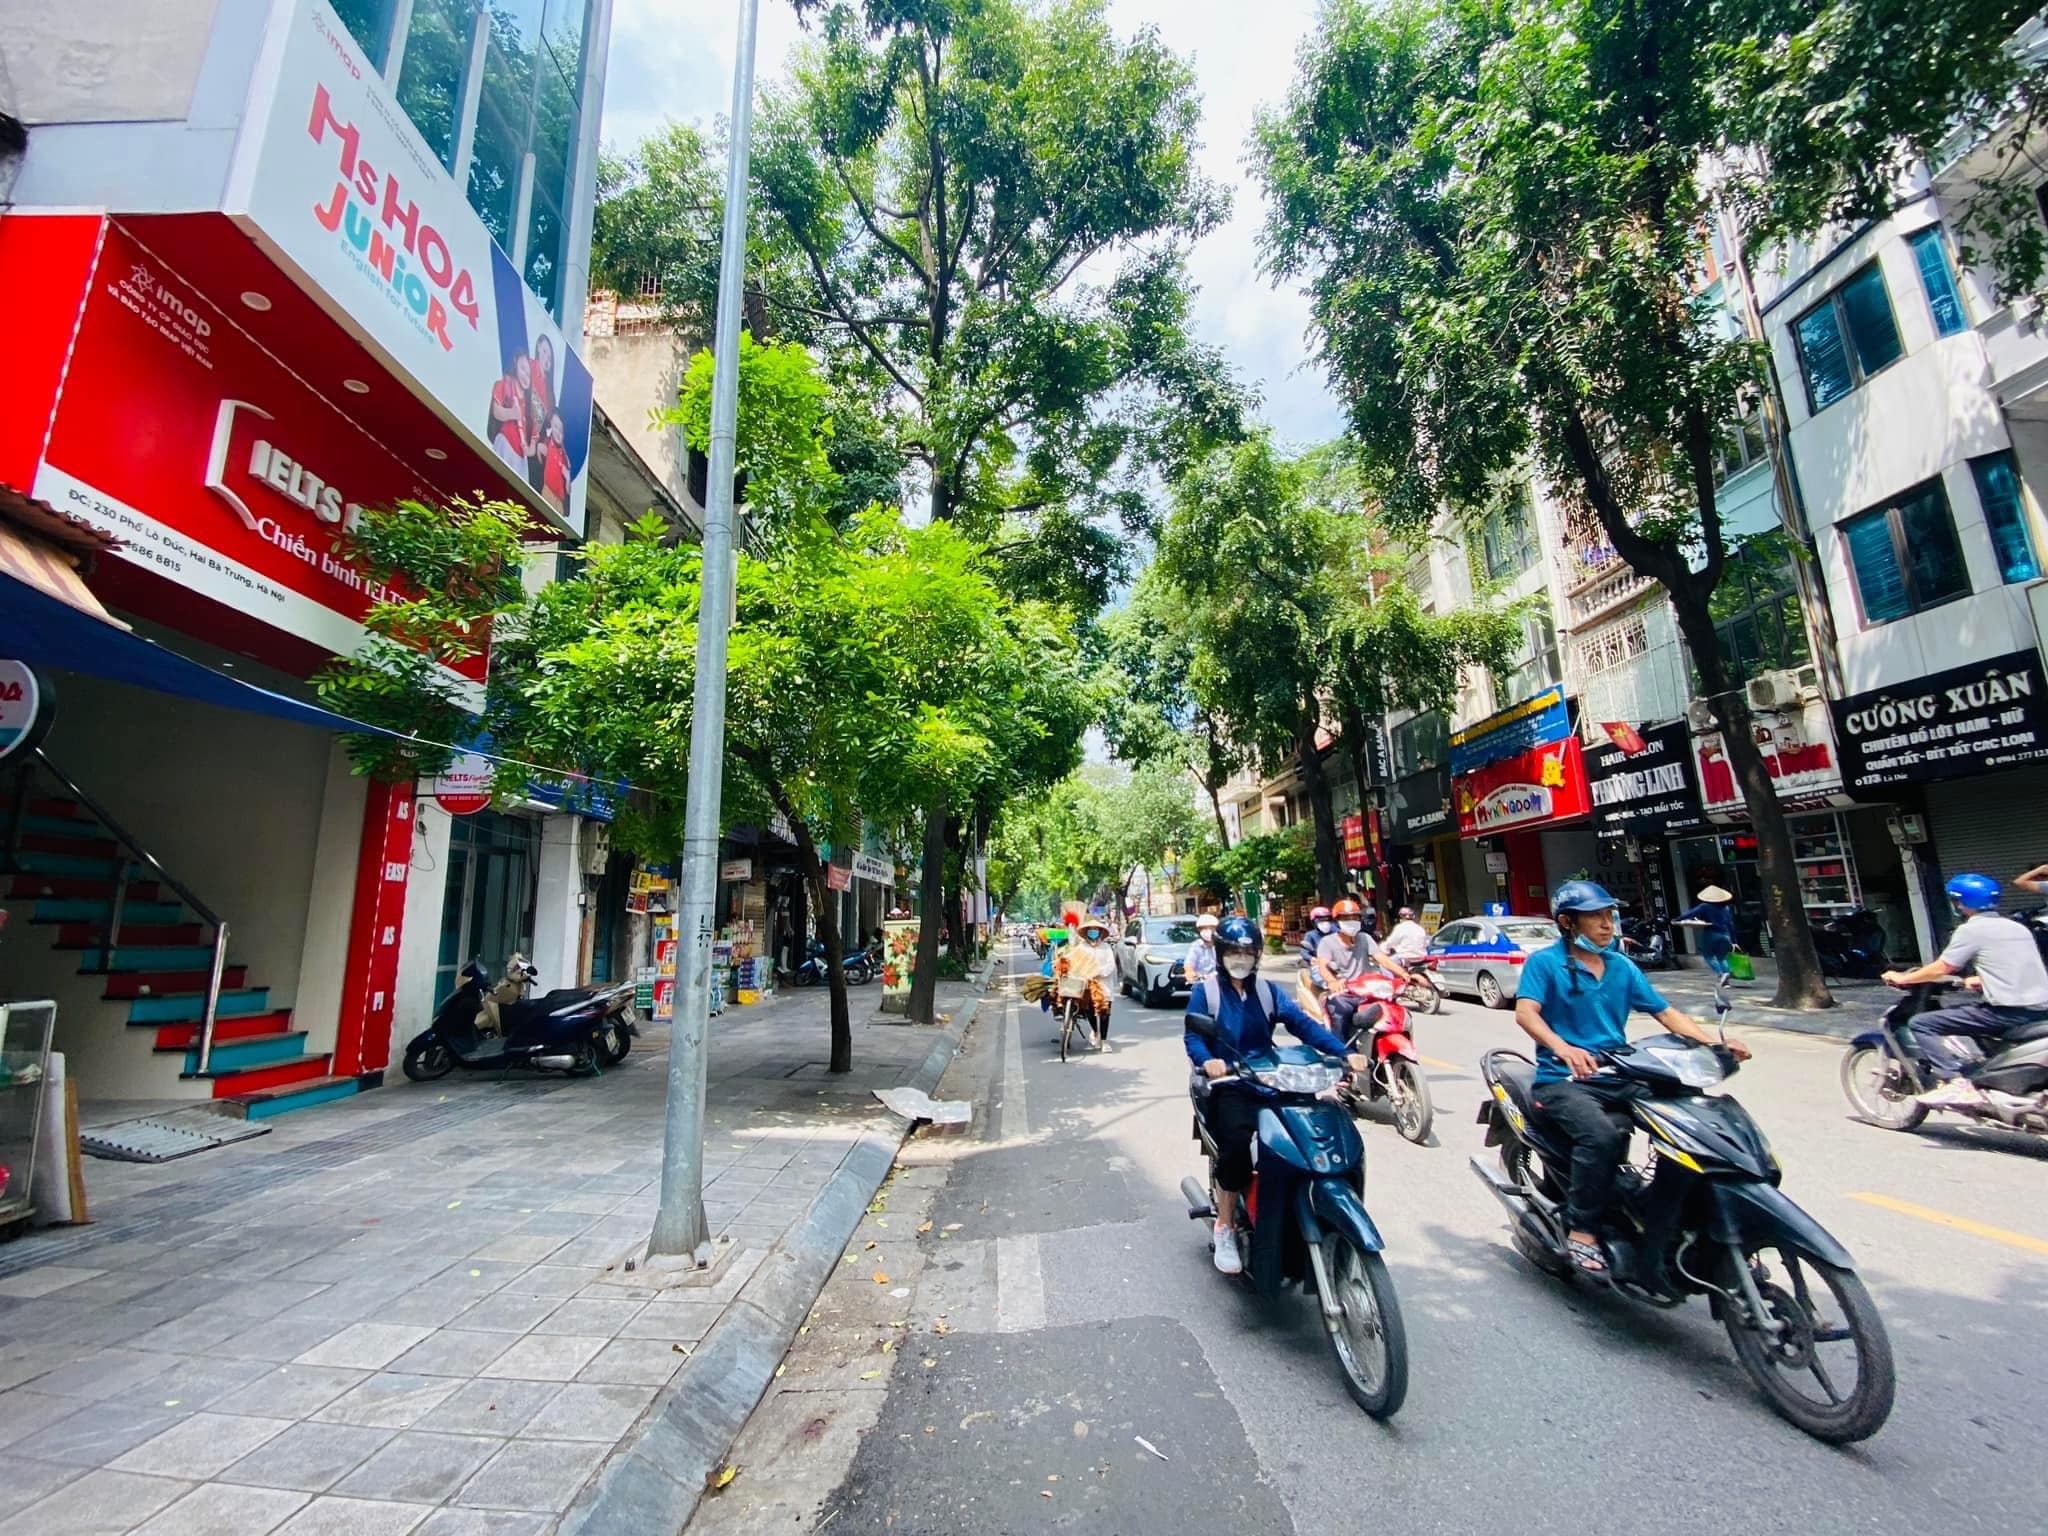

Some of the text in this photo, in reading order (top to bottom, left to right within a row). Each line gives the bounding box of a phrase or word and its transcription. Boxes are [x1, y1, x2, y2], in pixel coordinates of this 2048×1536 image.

[156, 284, 211, 337] imap
[340, 239, 435, 344] English for future
[249, 439, 343, 525] IELTS
[69, 488, 92, 508] ĐC:
[93, 502, 117, 520] 230
[119, 514, 143, 534] Phố
[189, 550, 207, 565] Hai
[207, 559, 222, 572] Bà
[256, 582, 269, 595] Hà
[270, 588, 286, 603] Nội
[155, 554, 182, 573] 8815
[257, 507, 317, 567] Chiến
[1846, 669, 2032, 734] CƯỜNG XUÂN
[1600, 751, 1627, 767] HAIR
[1861, 732, 1909, 754] CHUYÊN
[1955, 716, 1991, 736] NAM
[1643, 761, 1687, 796] LINH
